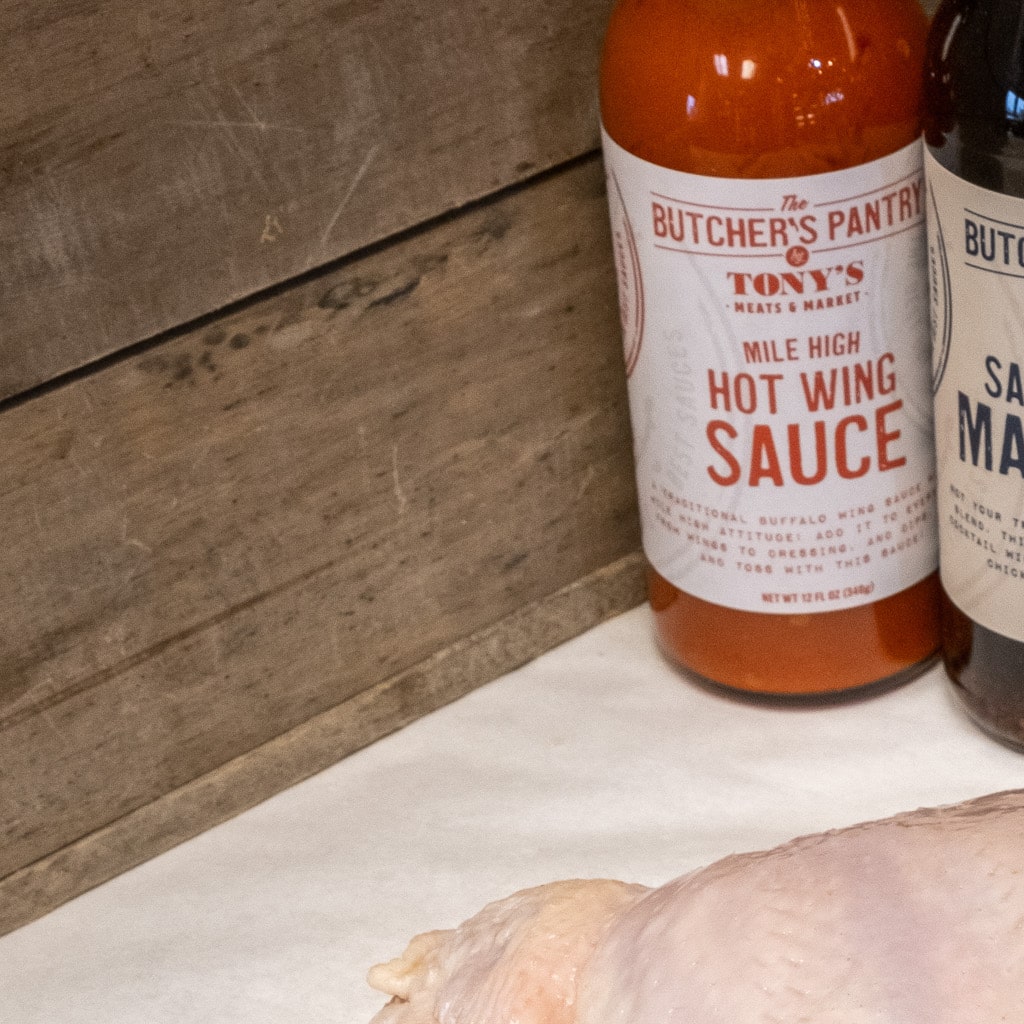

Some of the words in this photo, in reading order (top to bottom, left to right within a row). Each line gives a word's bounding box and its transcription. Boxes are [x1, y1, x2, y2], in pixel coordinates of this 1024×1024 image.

[652, 201, 818, 248] BUTCHER'S
[828, 178, 925, 241] PANTRY
[780, 194, 808, 212] The
[727, 261, 865, 297] TONY'S
[734, 302, 783, 315] MEATS
[789, 302, 797, 314] &
[803, 292, 861, 312] MARKET
[743, 339, 799, 364] MILE
[808, 331, 860, 359] HIGH
[707, 368, 783, 415] HOT
[800, 352, 896, 413] WING
[706, 398, 907, 488] SAUCE
[759, 514, 827, 526] BUFFALO
[838, 503, 875, 521] WING
[972, 502, 1002, 522] YOUR
[816, 528, 844, 541] ADD
[856, 519, 873, 534] IT
[739, 545, 756, 558] TO
[867, 531, 893, 547] AND
[737, 561, 773, 575] TOSS
[784, 563, 823, 575] WITH
[835, 553, 871, 570] THIS
